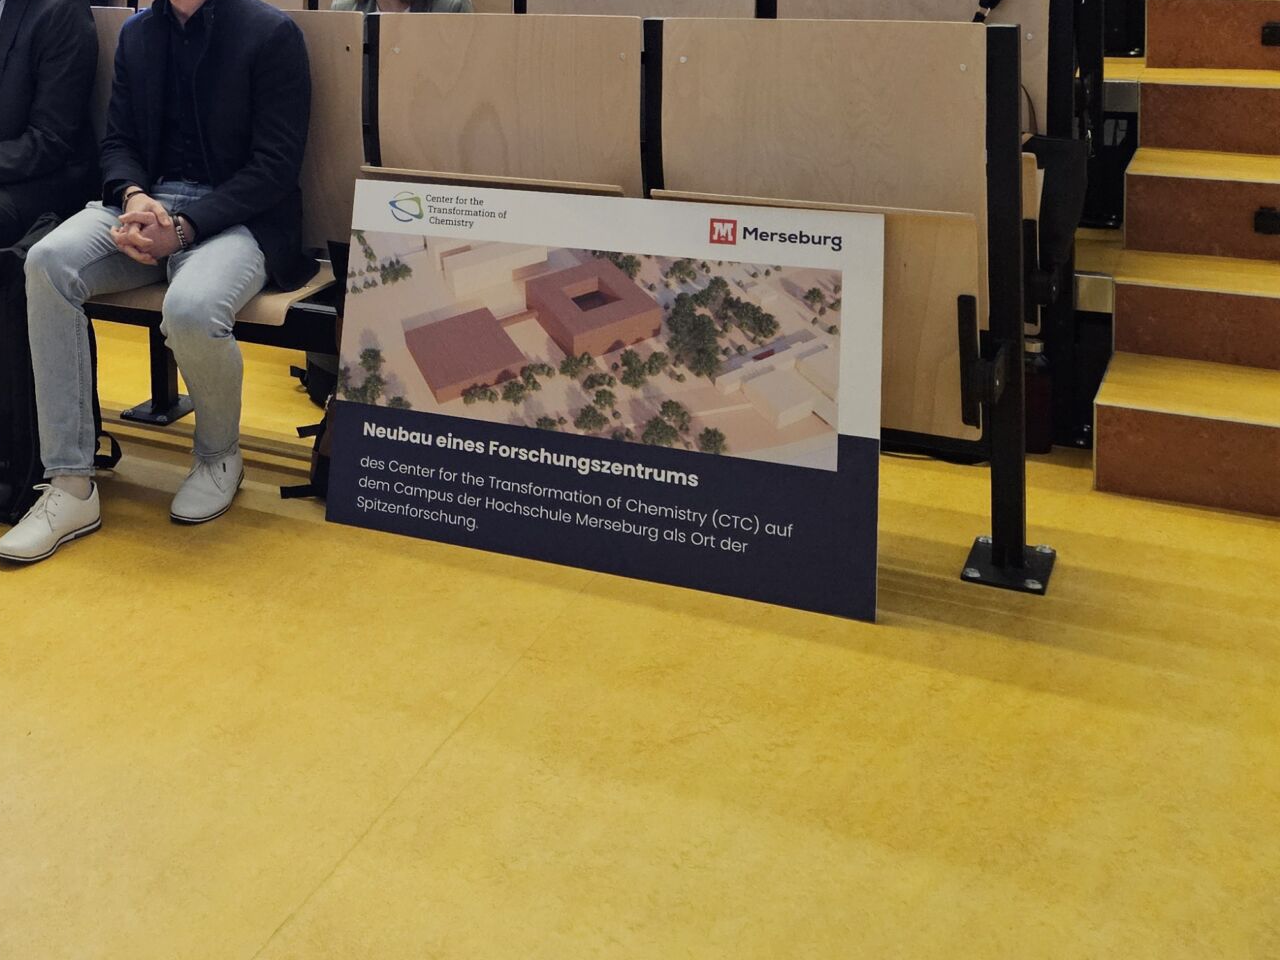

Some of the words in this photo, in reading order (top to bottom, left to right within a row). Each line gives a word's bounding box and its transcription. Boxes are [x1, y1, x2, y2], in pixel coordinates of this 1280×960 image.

[425, 194, 453, 204] Center
[456, 195, 469, 205] for
[470, 196, 484, 206] the
[428, 205, 496, 218] Transformation
[498, 210, 507, 219] of
[429, 216, 475, 229] Chemistry
[742, 226, 843, 252] Merseburg
[362, 421, 432, 446] Neubau
[435, 432, 485, 454] eines
[488, 440, 699, 487] Forschungszentrums
[360, 456, 385, 471] des
[388, 460, 435, 478] Center
[438, 467, 458, 483] for
[461, 472, 485, 487] the
[488, 475, 602, 507] Transformation
[606, 496, 622, 509] of
[625, 498, 708, 527] Chemistry
[712, 508, 760, 535] (CTC)
[764, 523, 794, 538] auf
[356, 495, 479, 532] Spitzenforschung.
[358, 476, 390, 492] dem
[393, 481, 454, 503] Campus
[457, 492, 482, 508] der
[485, 496, 572, 523] Hochschule
[575, 512, 659, 542] Merseburg
[662, 528, 686, 543] als
[690, 532, 716, 549] Ort
[719, 537, 749, 553] der
